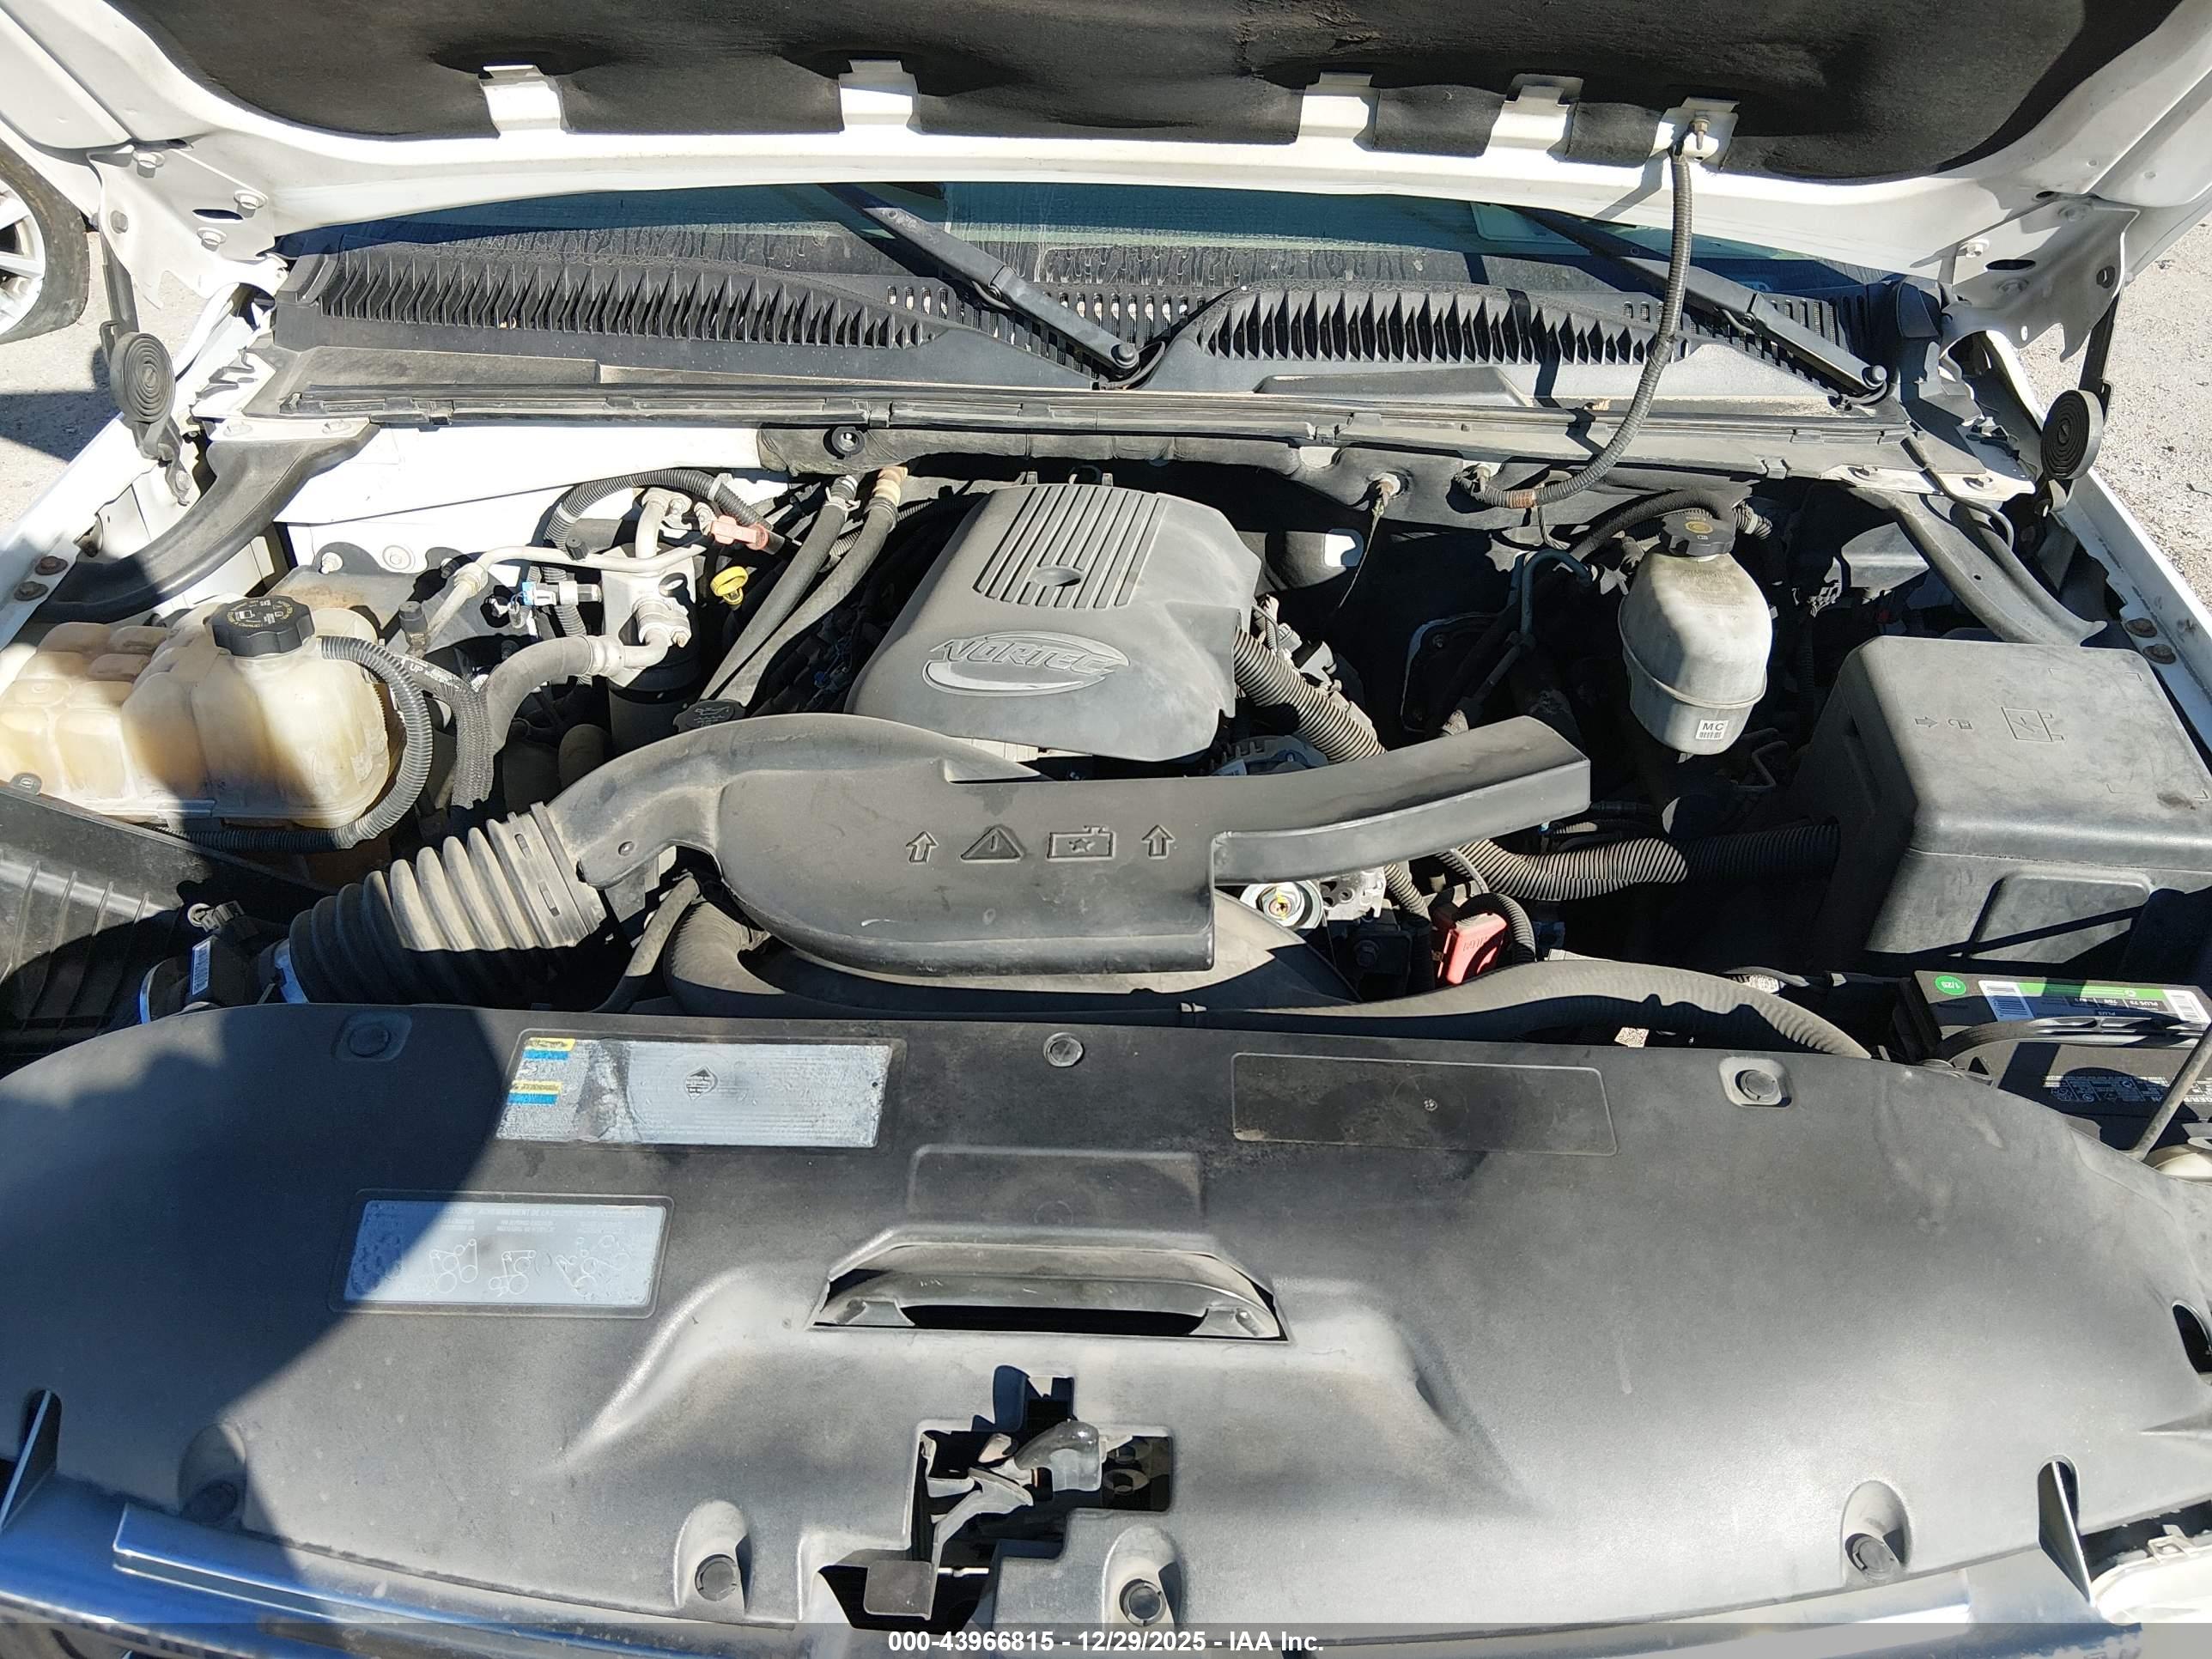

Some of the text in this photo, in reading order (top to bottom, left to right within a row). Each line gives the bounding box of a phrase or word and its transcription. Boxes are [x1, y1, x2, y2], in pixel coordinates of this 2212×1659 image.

[937, 639, 1113, 676] VORTEC
[410, 662, 423, 673] UP
[1702, 722, 1724, 731] MC
